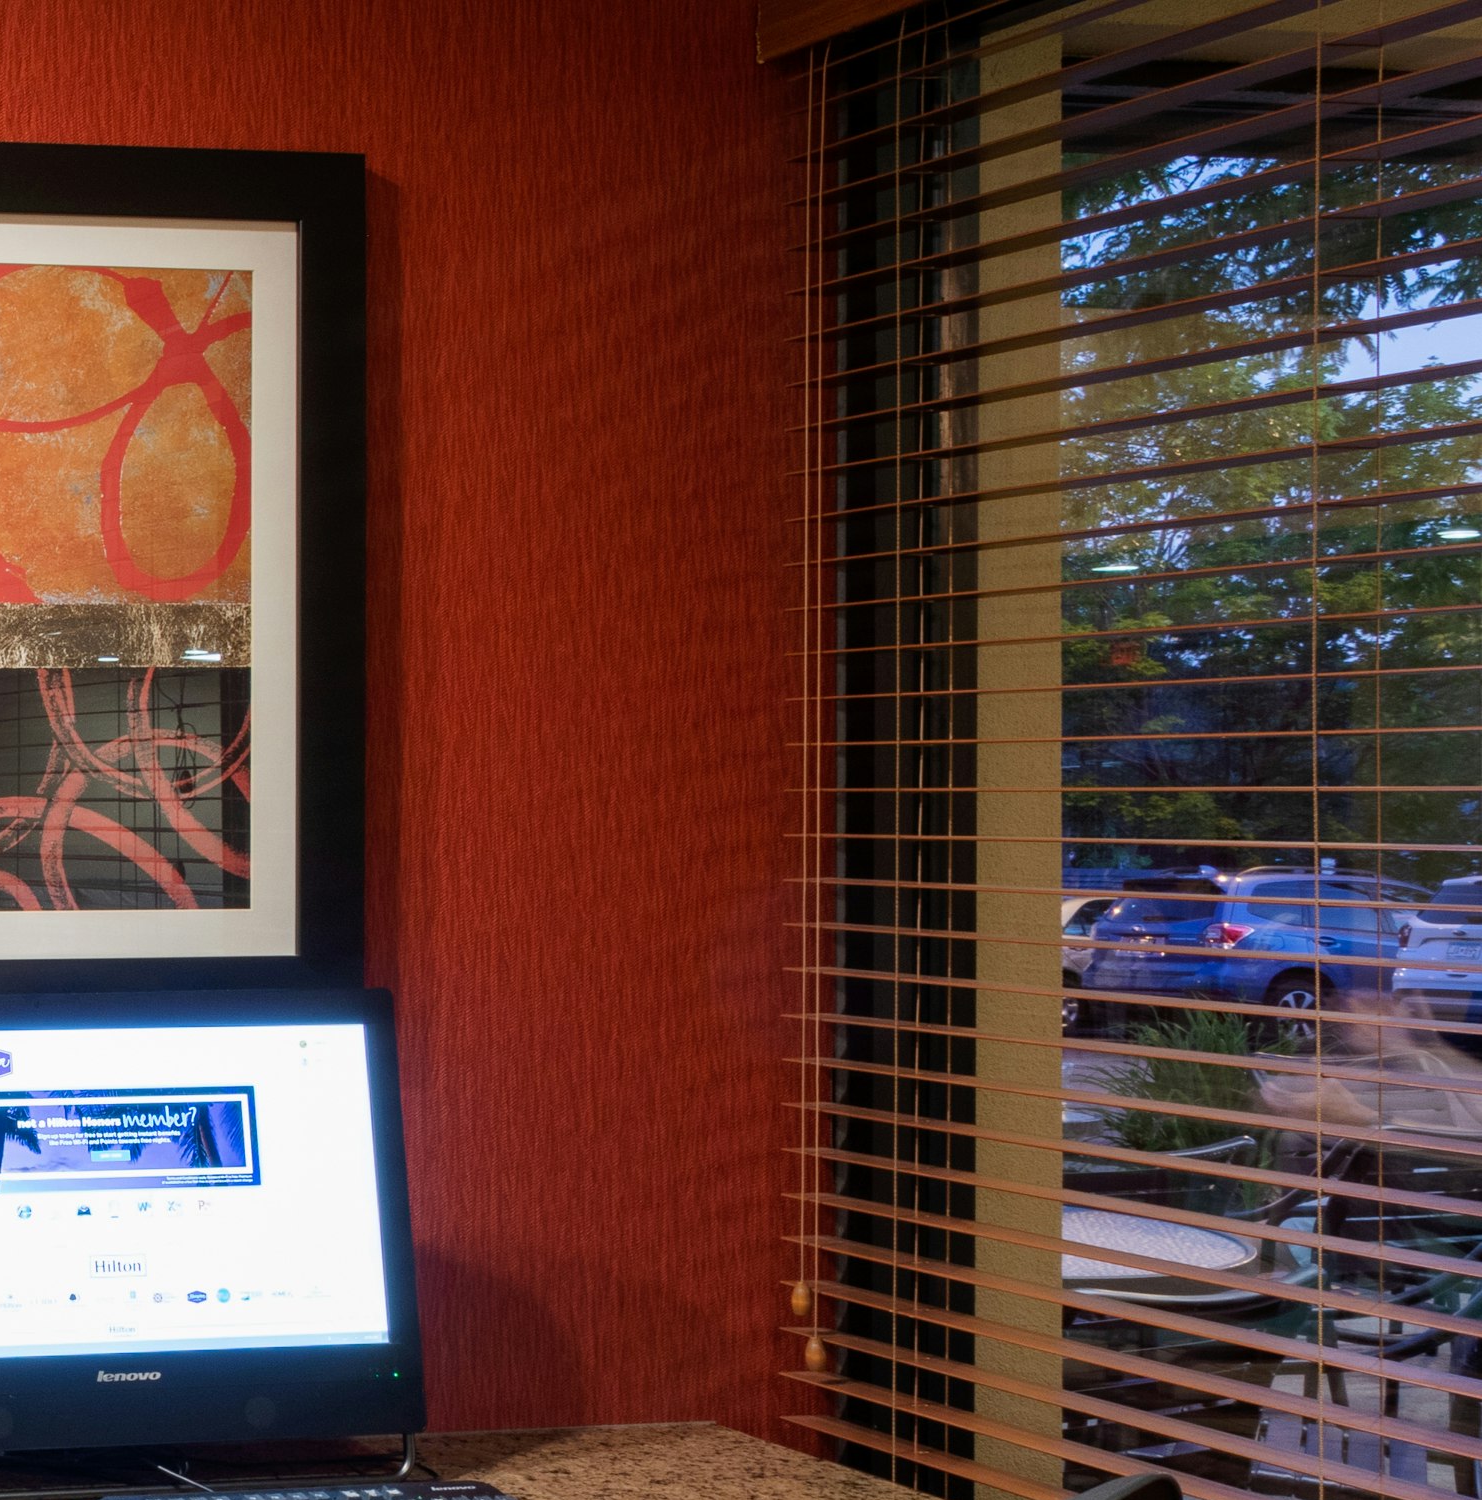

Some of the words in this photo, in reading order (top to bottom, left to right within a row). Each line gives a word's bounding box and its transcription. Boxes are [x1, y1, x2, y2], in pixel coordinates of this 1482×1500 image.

[17, 1119, 37, 1129] not
[47, 1116, 81, 1128] Hilton
[82, 1115, 122, 1127] Honors
[123, 1105, 197, 1128] member?
[95, 1260, 142, 1272] Hilton
[96, 1370, 162, 1382] lenovo
